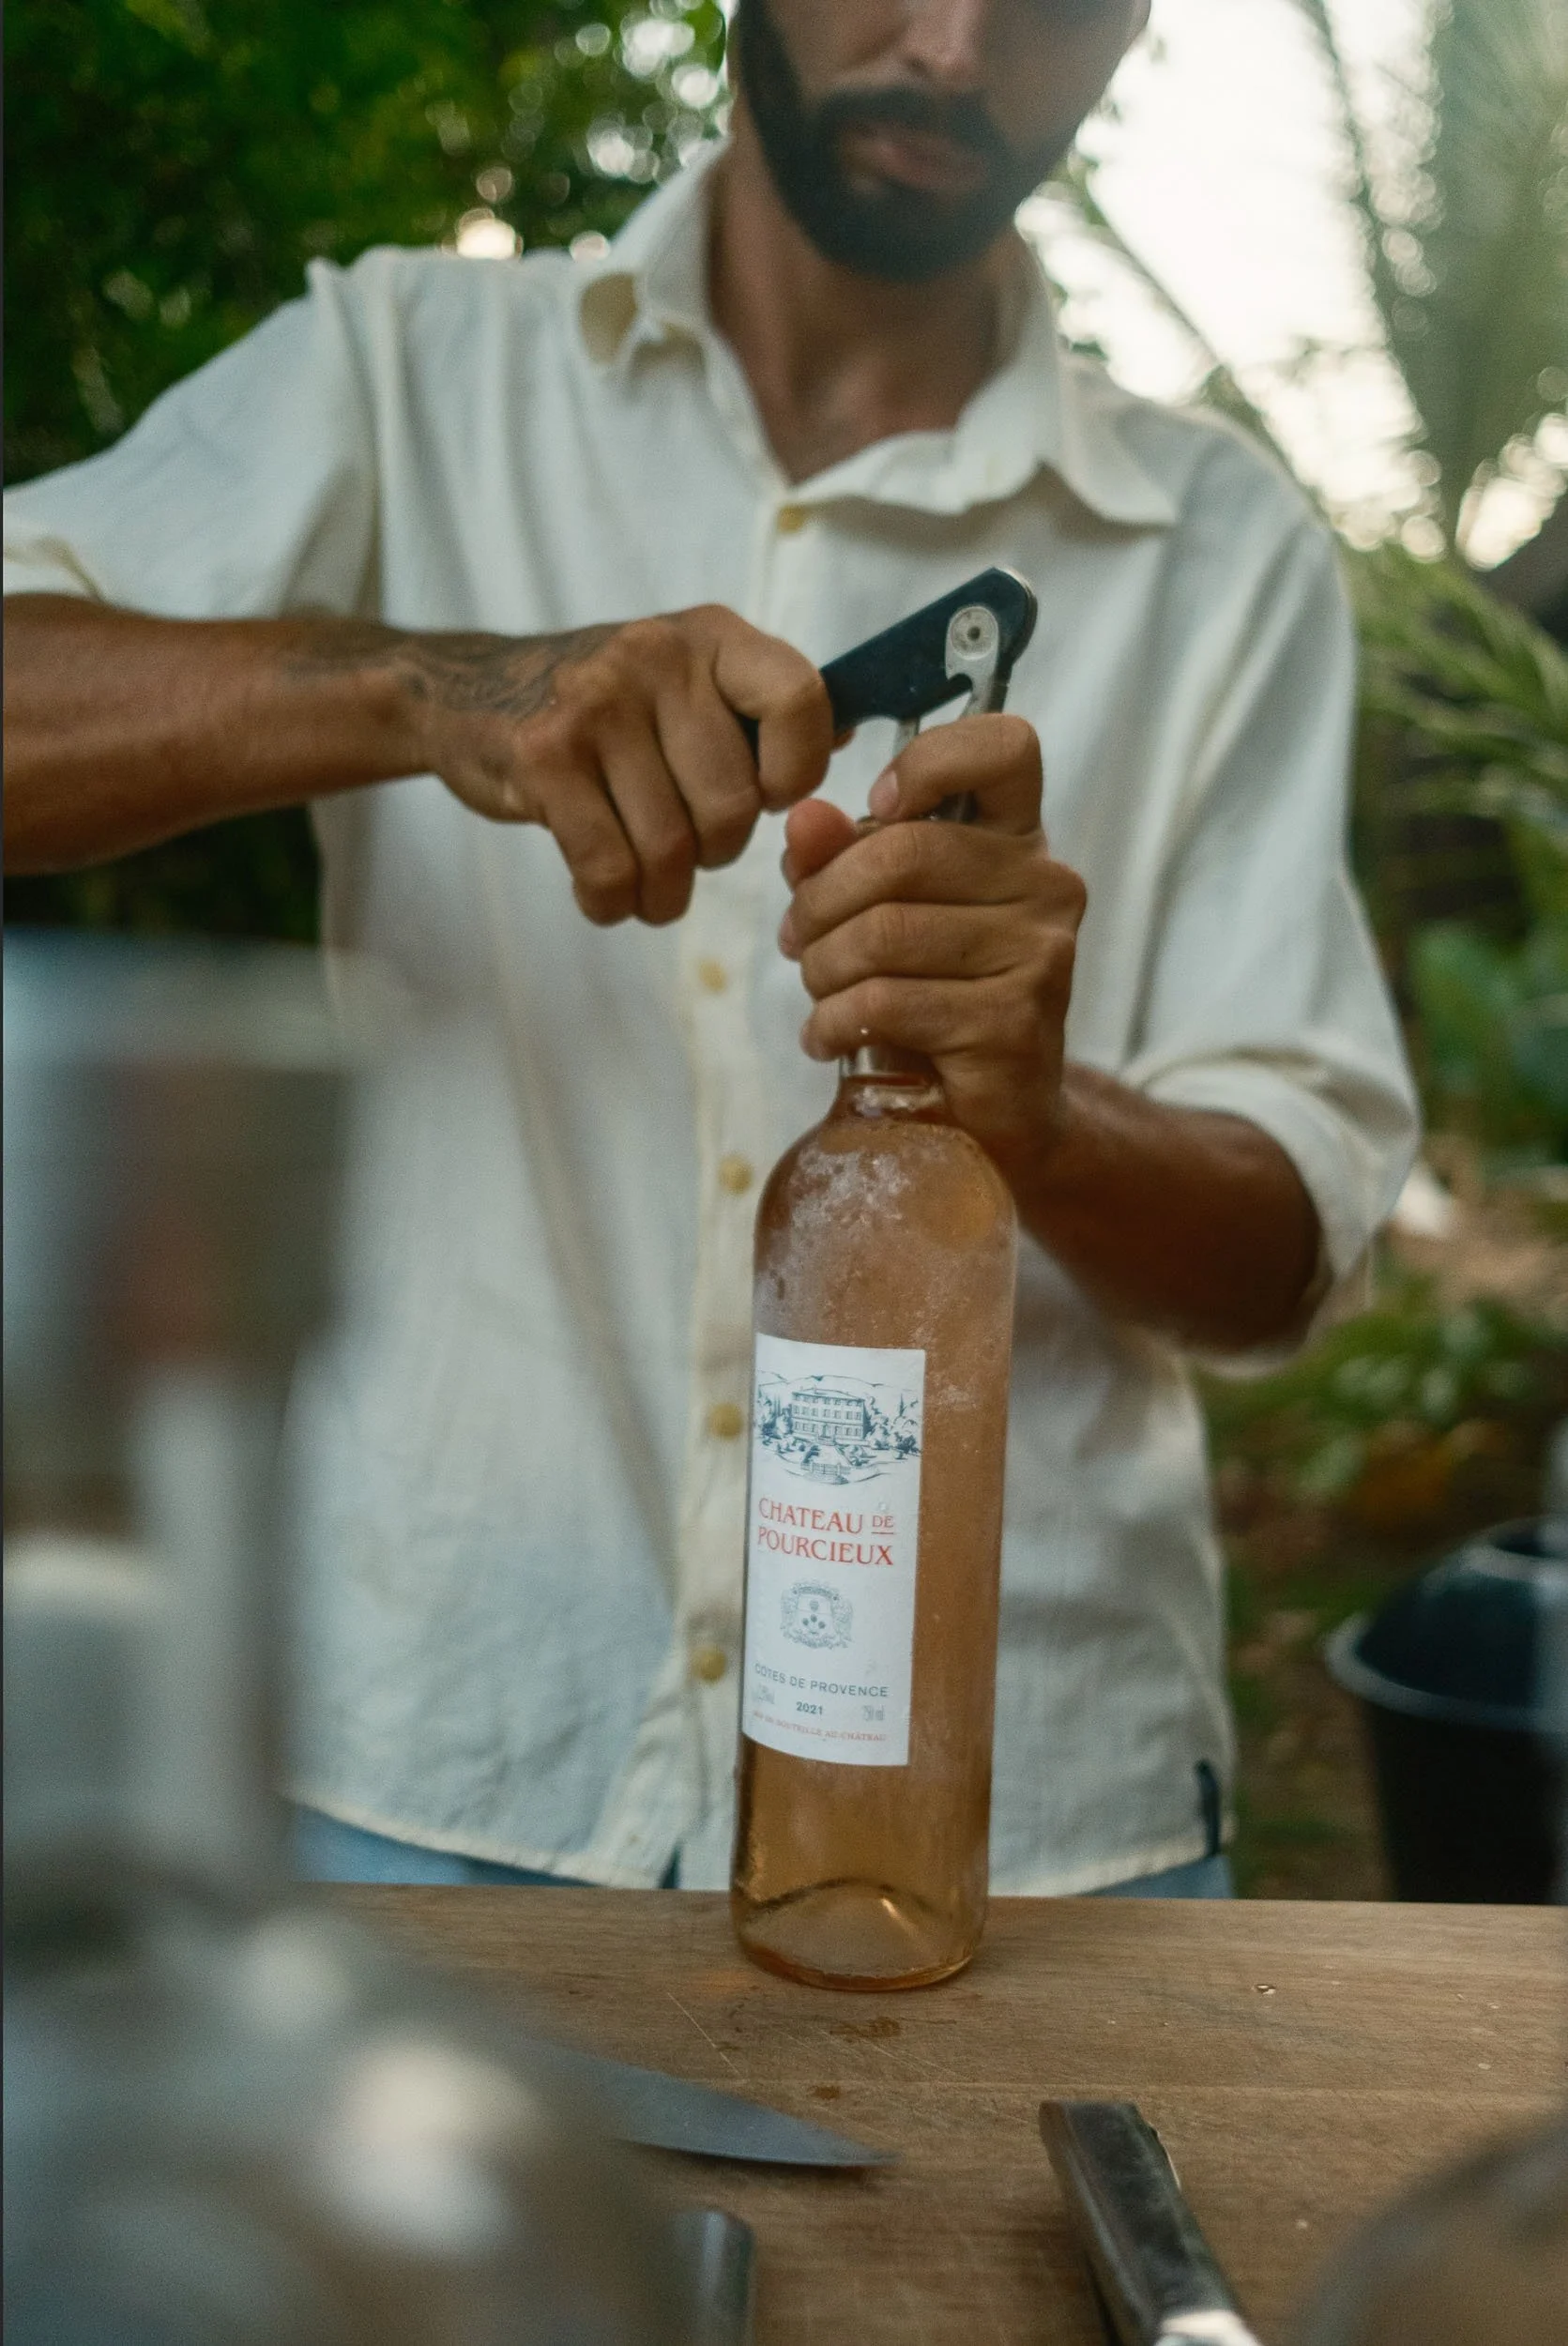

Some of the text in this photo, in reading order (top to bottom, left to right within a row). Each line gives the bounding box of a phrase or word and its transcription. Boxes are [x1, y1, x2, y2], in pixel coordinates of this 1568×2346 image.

[758, 1498, 894, 1534] CHATEAU DE
[758, 1526, 894, 1565] POURCIEUX
[789, 1676, 806, 1689] DE
[810, 1680, 890, 1698] PROVENCE
[796, 1701, 823, 1715] 2021
